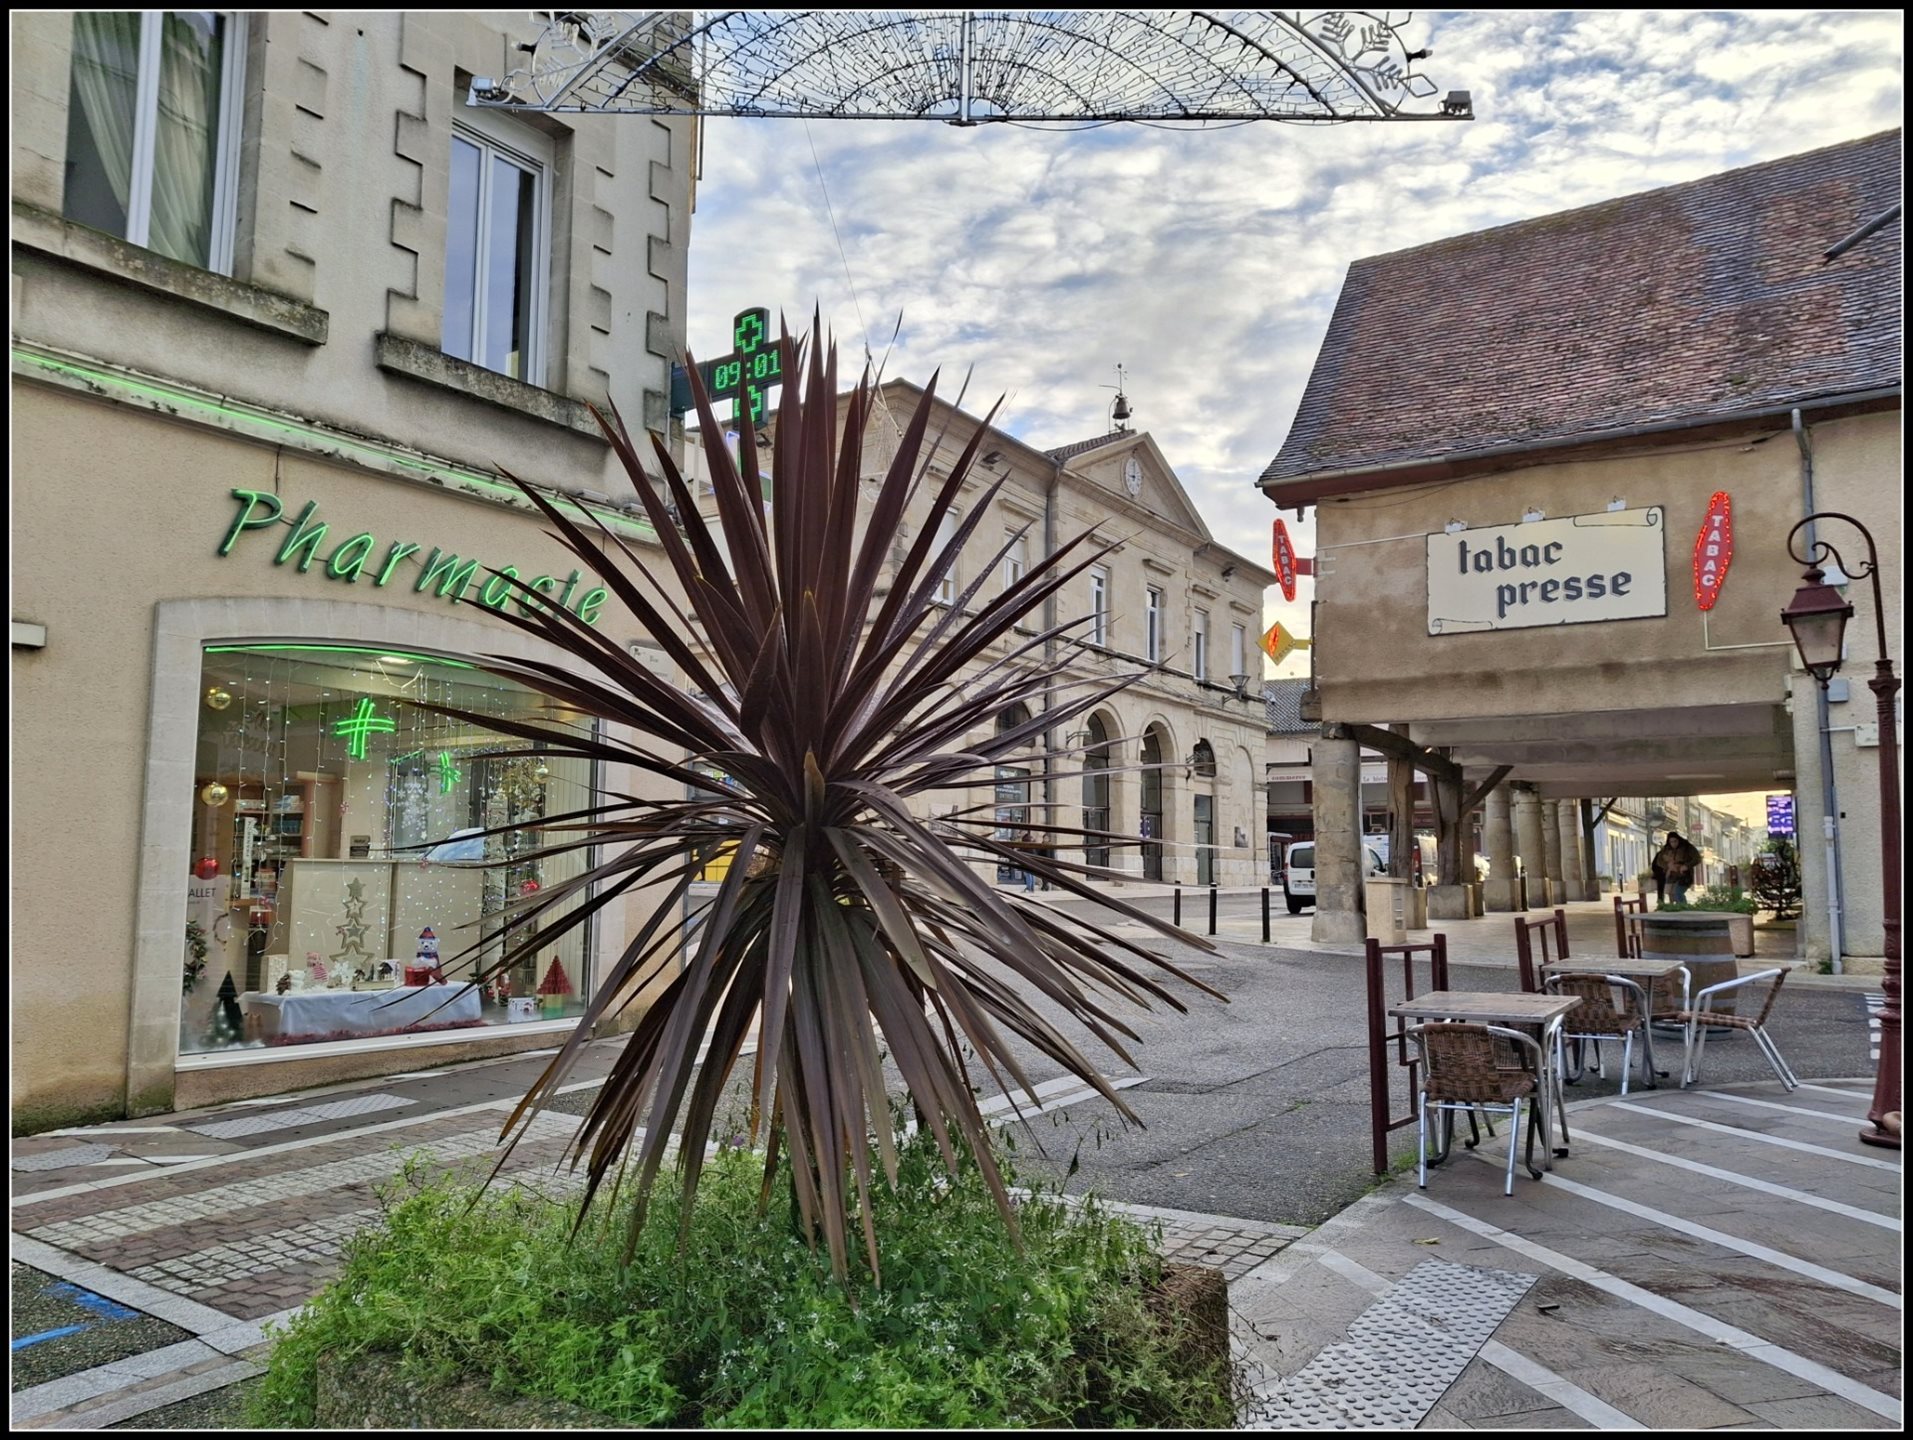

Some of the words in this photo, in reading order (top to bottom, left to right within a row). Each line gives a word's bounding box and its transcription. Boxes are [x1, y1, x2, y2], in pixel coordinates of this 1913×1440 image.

[715, 349, 782, 390] 09:01
[217, 488, 609, 626] Pharmacie
[1278, 535, 1293, 585] TABAC
[1457, 535, 1563, 575] tabac
[1702, 515, 1724, 586] TABAC
[1495, 571, 1632, 620] presse
